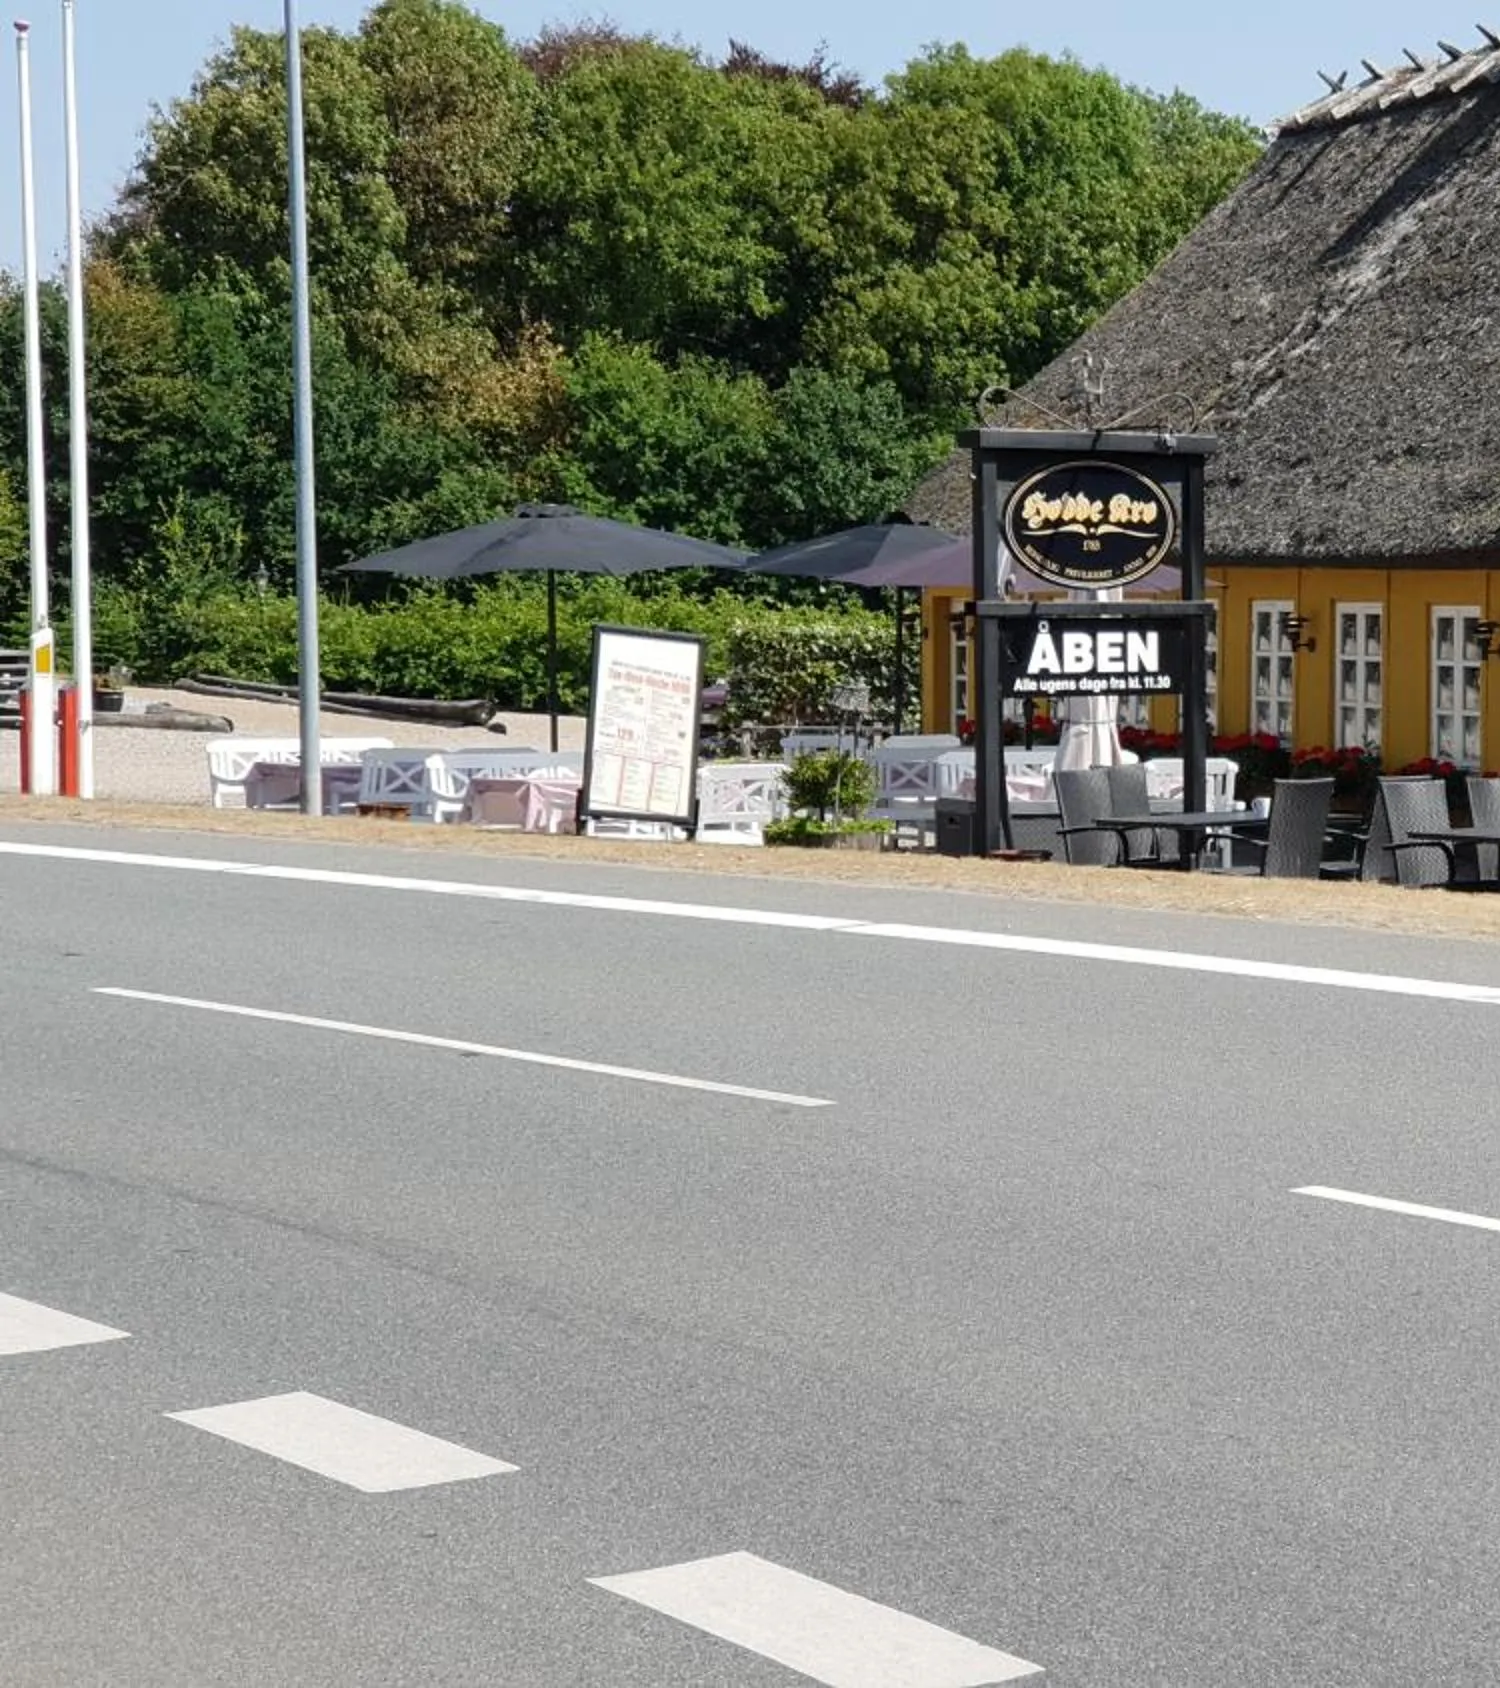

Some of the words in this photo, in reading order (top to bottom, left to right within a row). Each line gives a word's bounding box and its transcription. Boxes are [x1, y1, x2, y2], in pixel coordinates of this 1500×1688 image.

[1108, 493, 1158, 524] Kro
[1026, 620, 1160, 675] ÅBEN
[1013, 677, 1038, 692] Alle
[1039, 679, 1077, 695] ugens
[1079, 677, 1108, 693] dage
[1109, 677, 1126, 690] fra
[1127, 675, 1143, 690] kl.
[1144, 675, 1172, 689] 11.30
